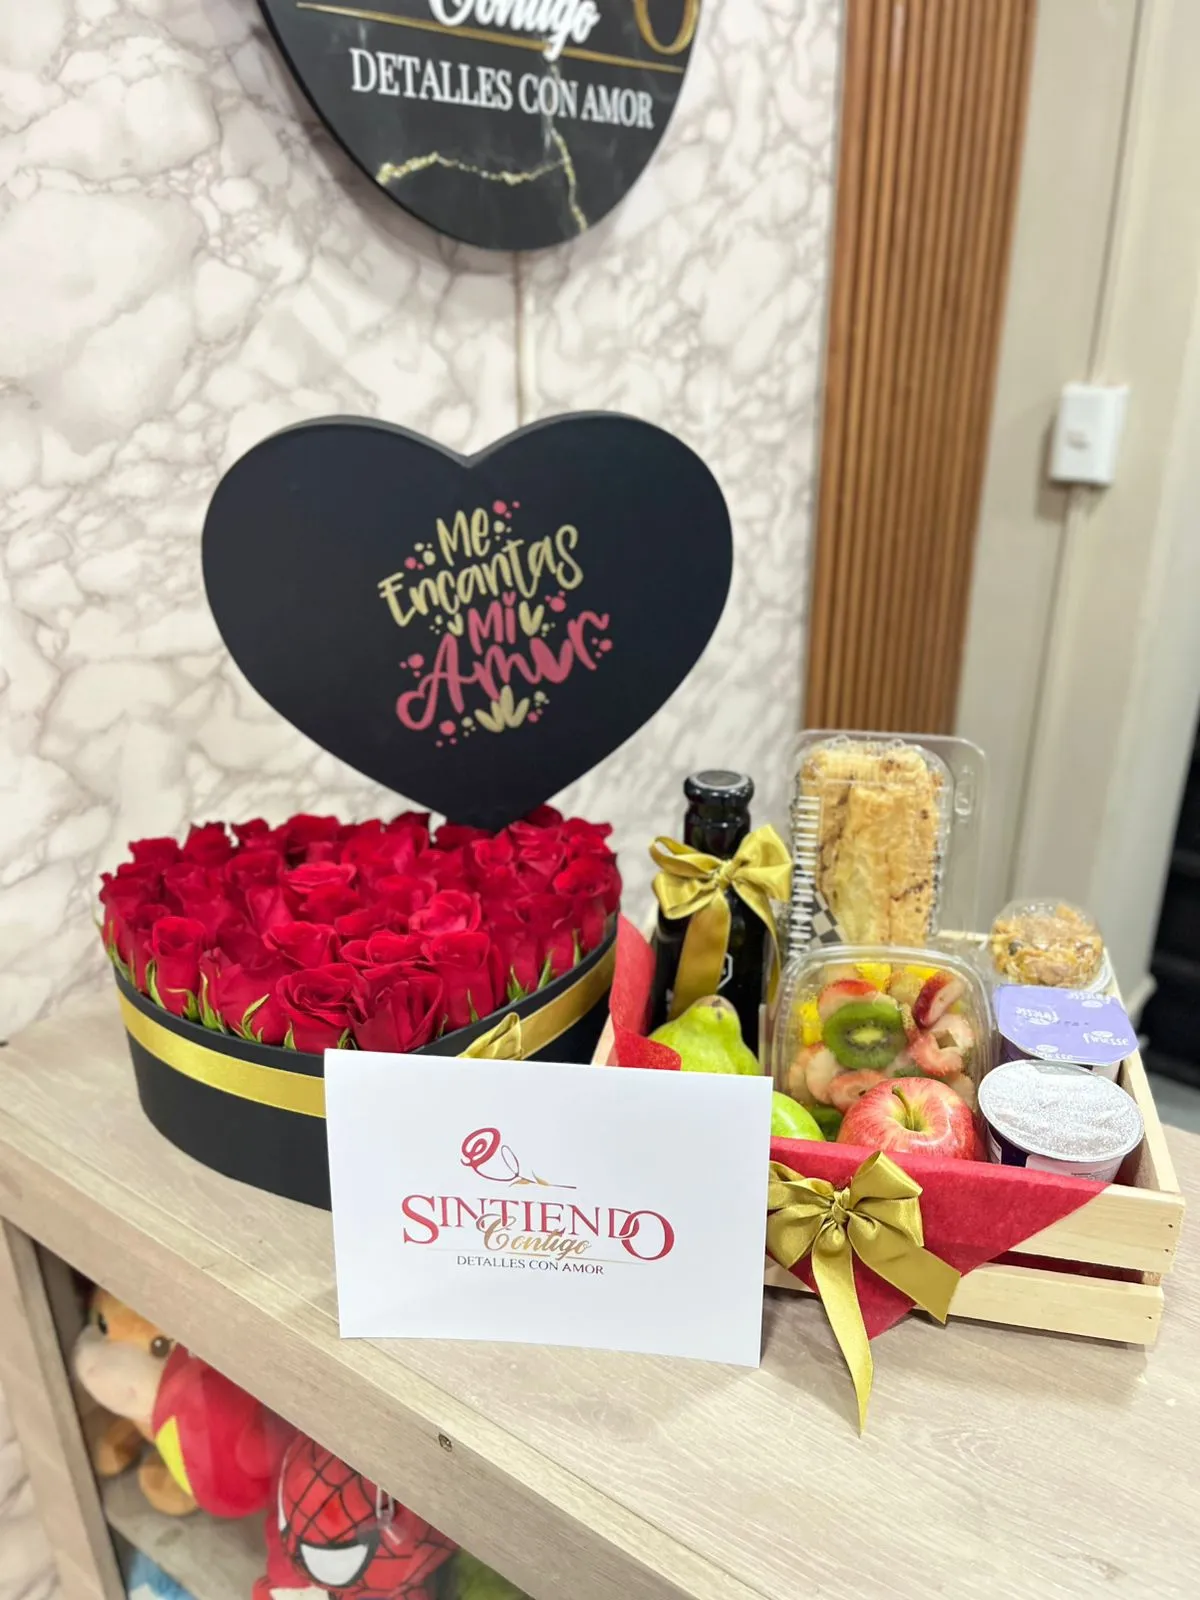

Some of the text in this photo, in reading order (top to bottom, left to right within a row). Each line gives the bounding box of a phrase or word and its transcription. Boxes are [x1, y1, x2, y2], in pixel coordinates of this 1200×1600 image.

[349, 47, 654, 129] DETALLES CON AMOR
[436, 507, 490, 566] Me
[377, 524, 584, 627] Encantas
[468, 591, 517, 655] Mi
[401, 1194, 675, 1261] SINTIENDO
[475, 1213, 593, 1261] Contigo
[456, 1255, 605, 1276] DETALLES CON AMOR
